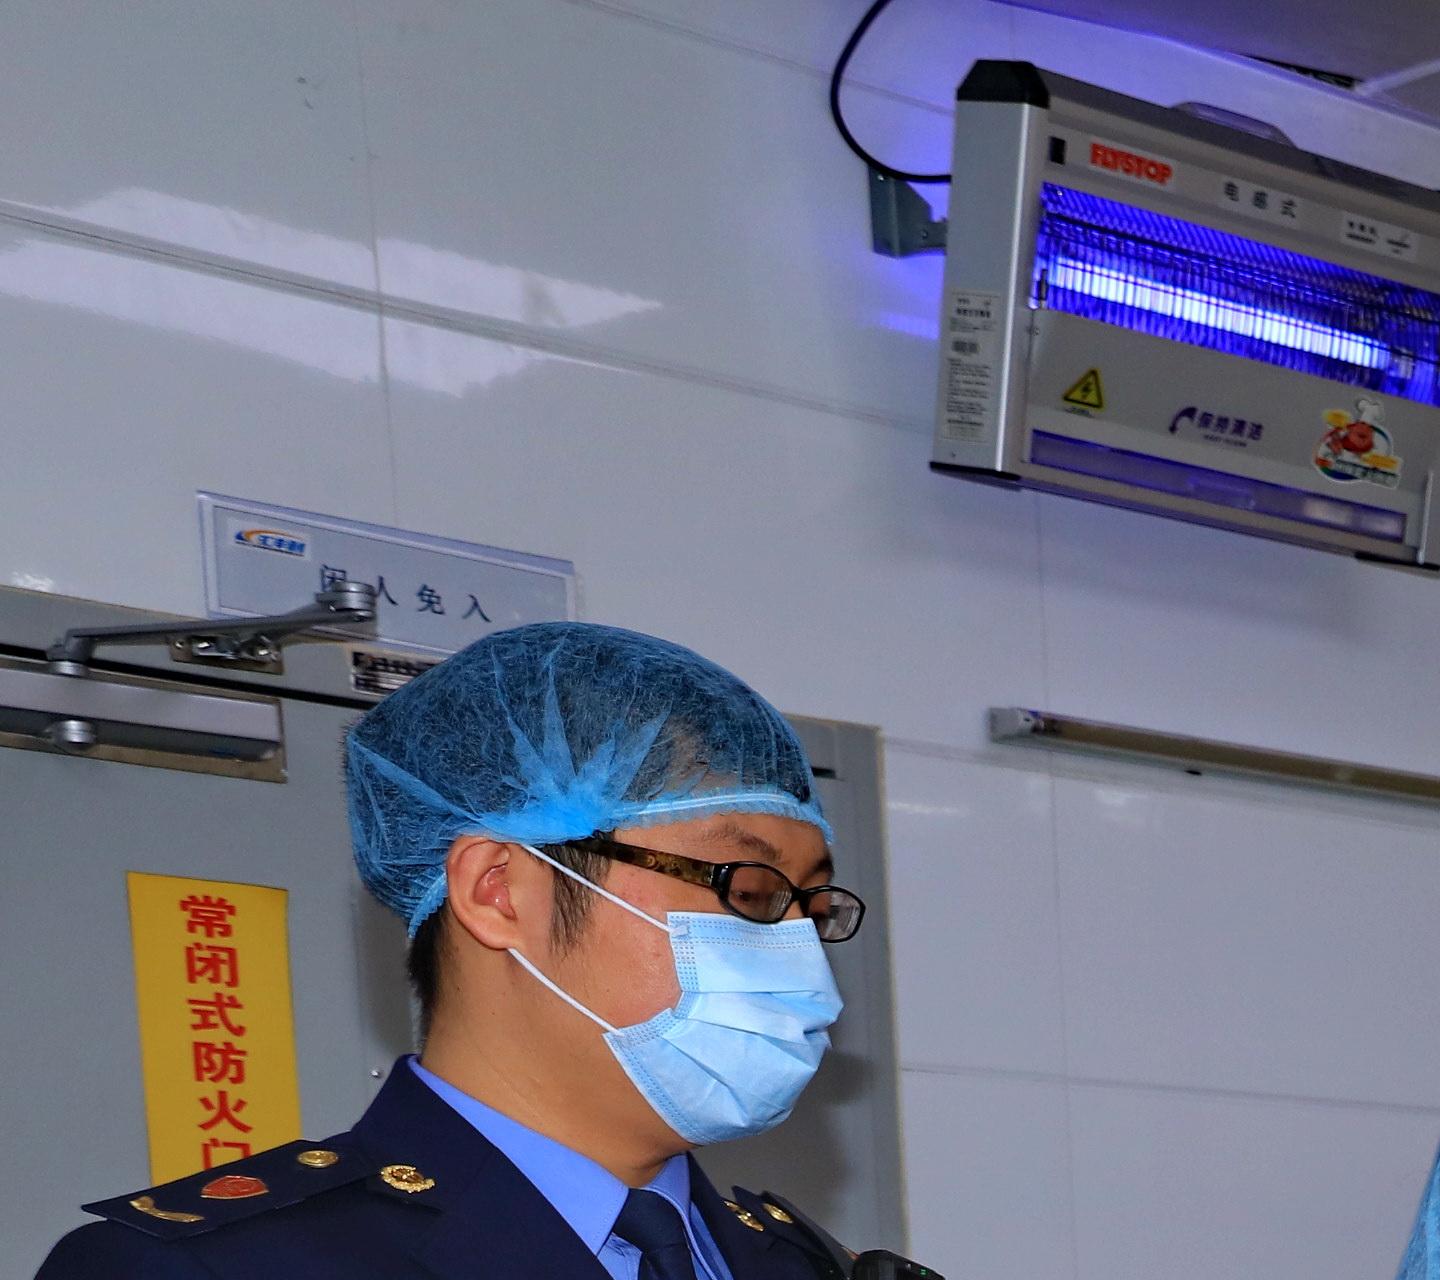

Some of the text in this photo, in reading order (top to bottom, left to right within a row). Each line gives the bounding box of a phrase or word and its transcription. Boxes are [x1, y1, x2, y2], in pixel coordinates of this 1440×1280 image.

[1090, 142, 1173, 186] FLYSTOP
[179, 894, 253, 1170] 常闭式防火门
